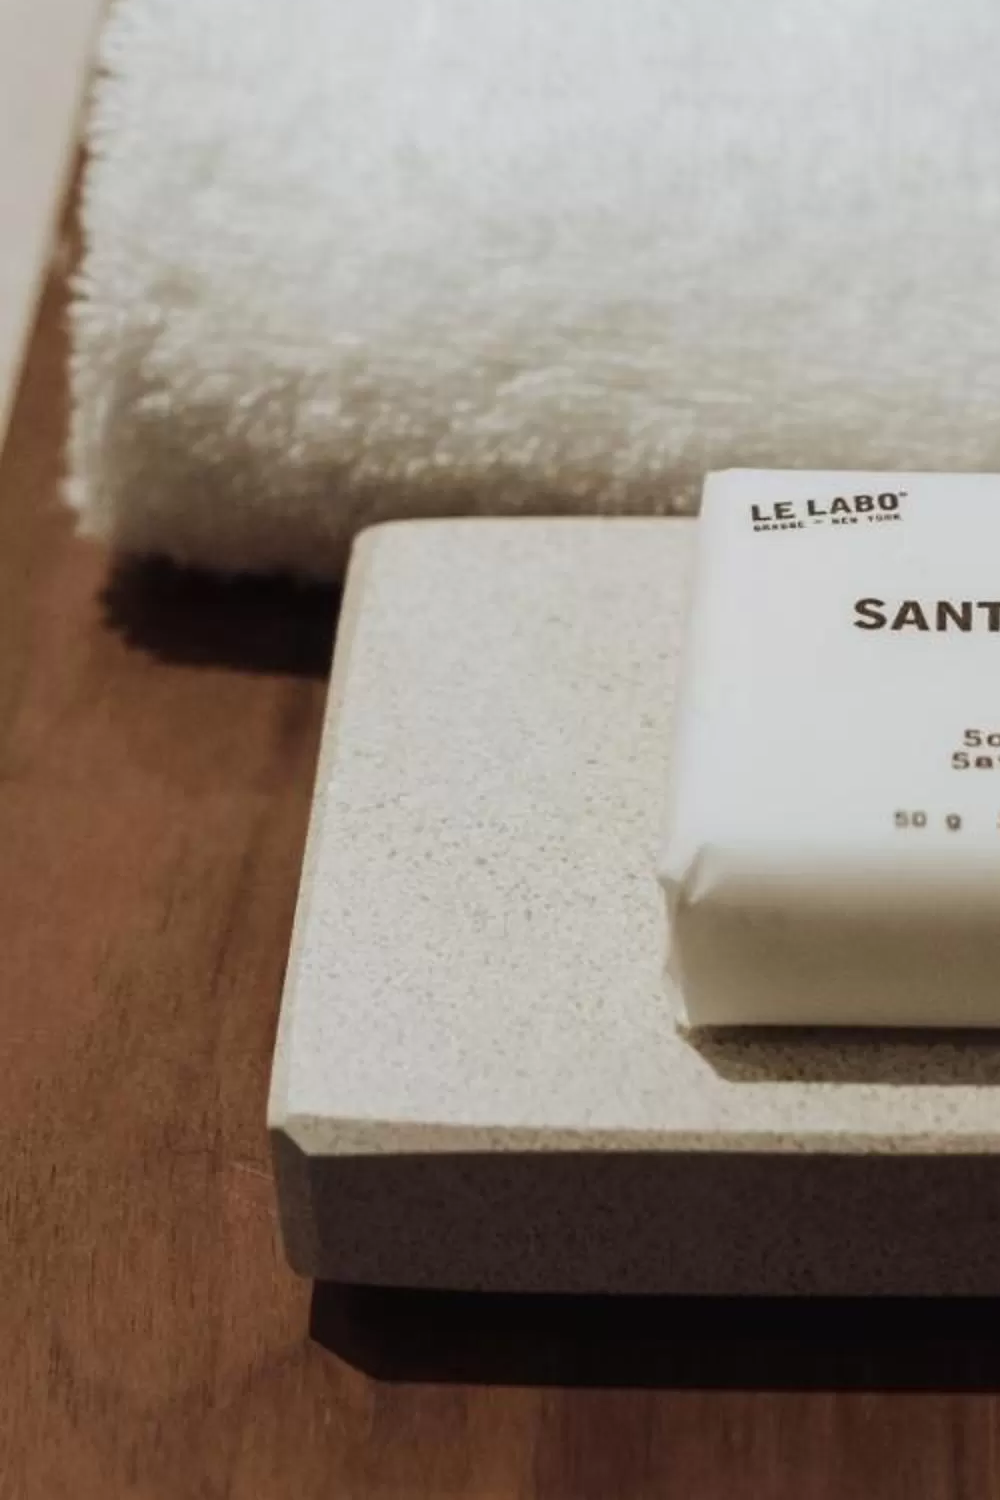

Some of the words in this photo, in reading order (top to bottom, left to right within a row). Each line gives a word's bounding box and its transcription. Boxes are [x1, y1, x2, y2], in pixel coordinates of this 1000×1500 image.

[751, 501, 796, 521] LE
[895, 810, 928, 829] 50
[945, 813, 962, 832] g
